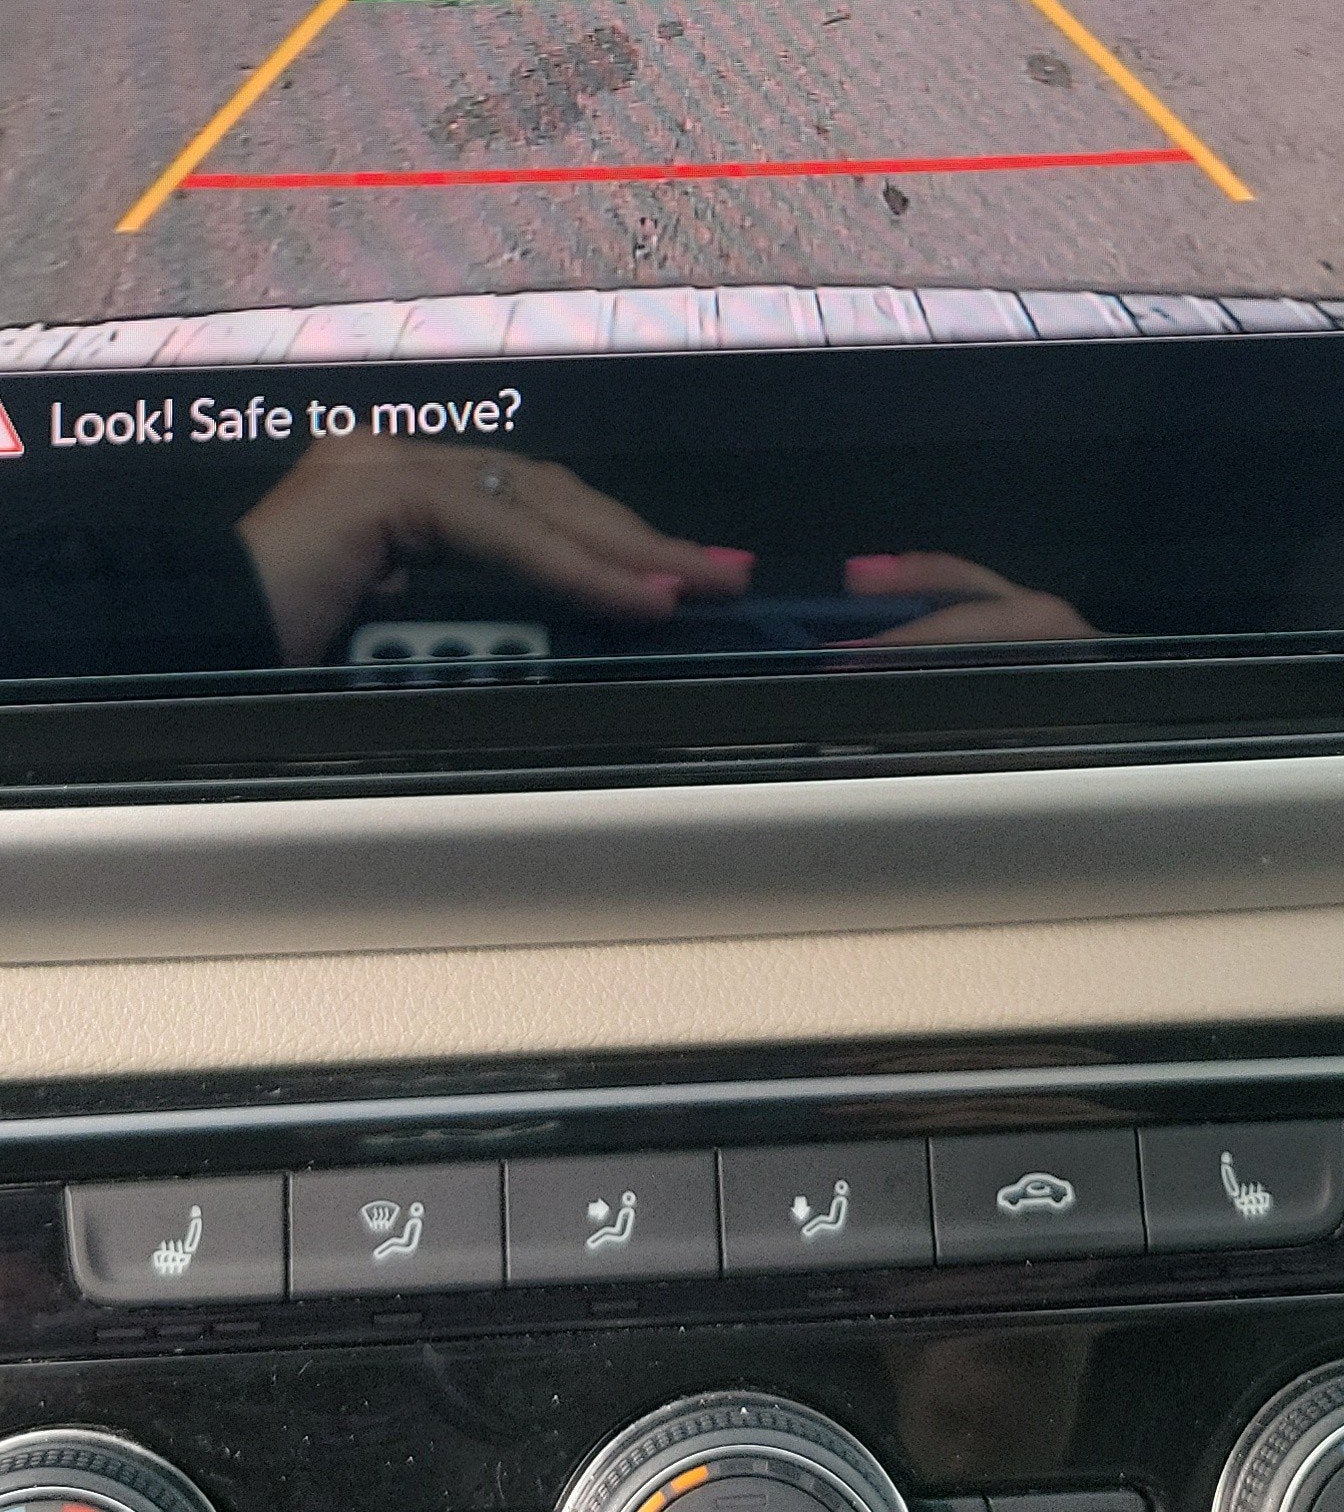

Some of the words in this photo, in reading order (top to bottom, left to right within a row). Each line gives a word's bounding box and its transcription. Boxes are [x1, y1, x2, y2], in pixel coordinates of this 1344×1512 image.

[50, 399, 174, 447] Look!
[189, 396, 293, 442] Safe
[306, 399, 356, 438] to
[371, 388, 523, 437] move?
